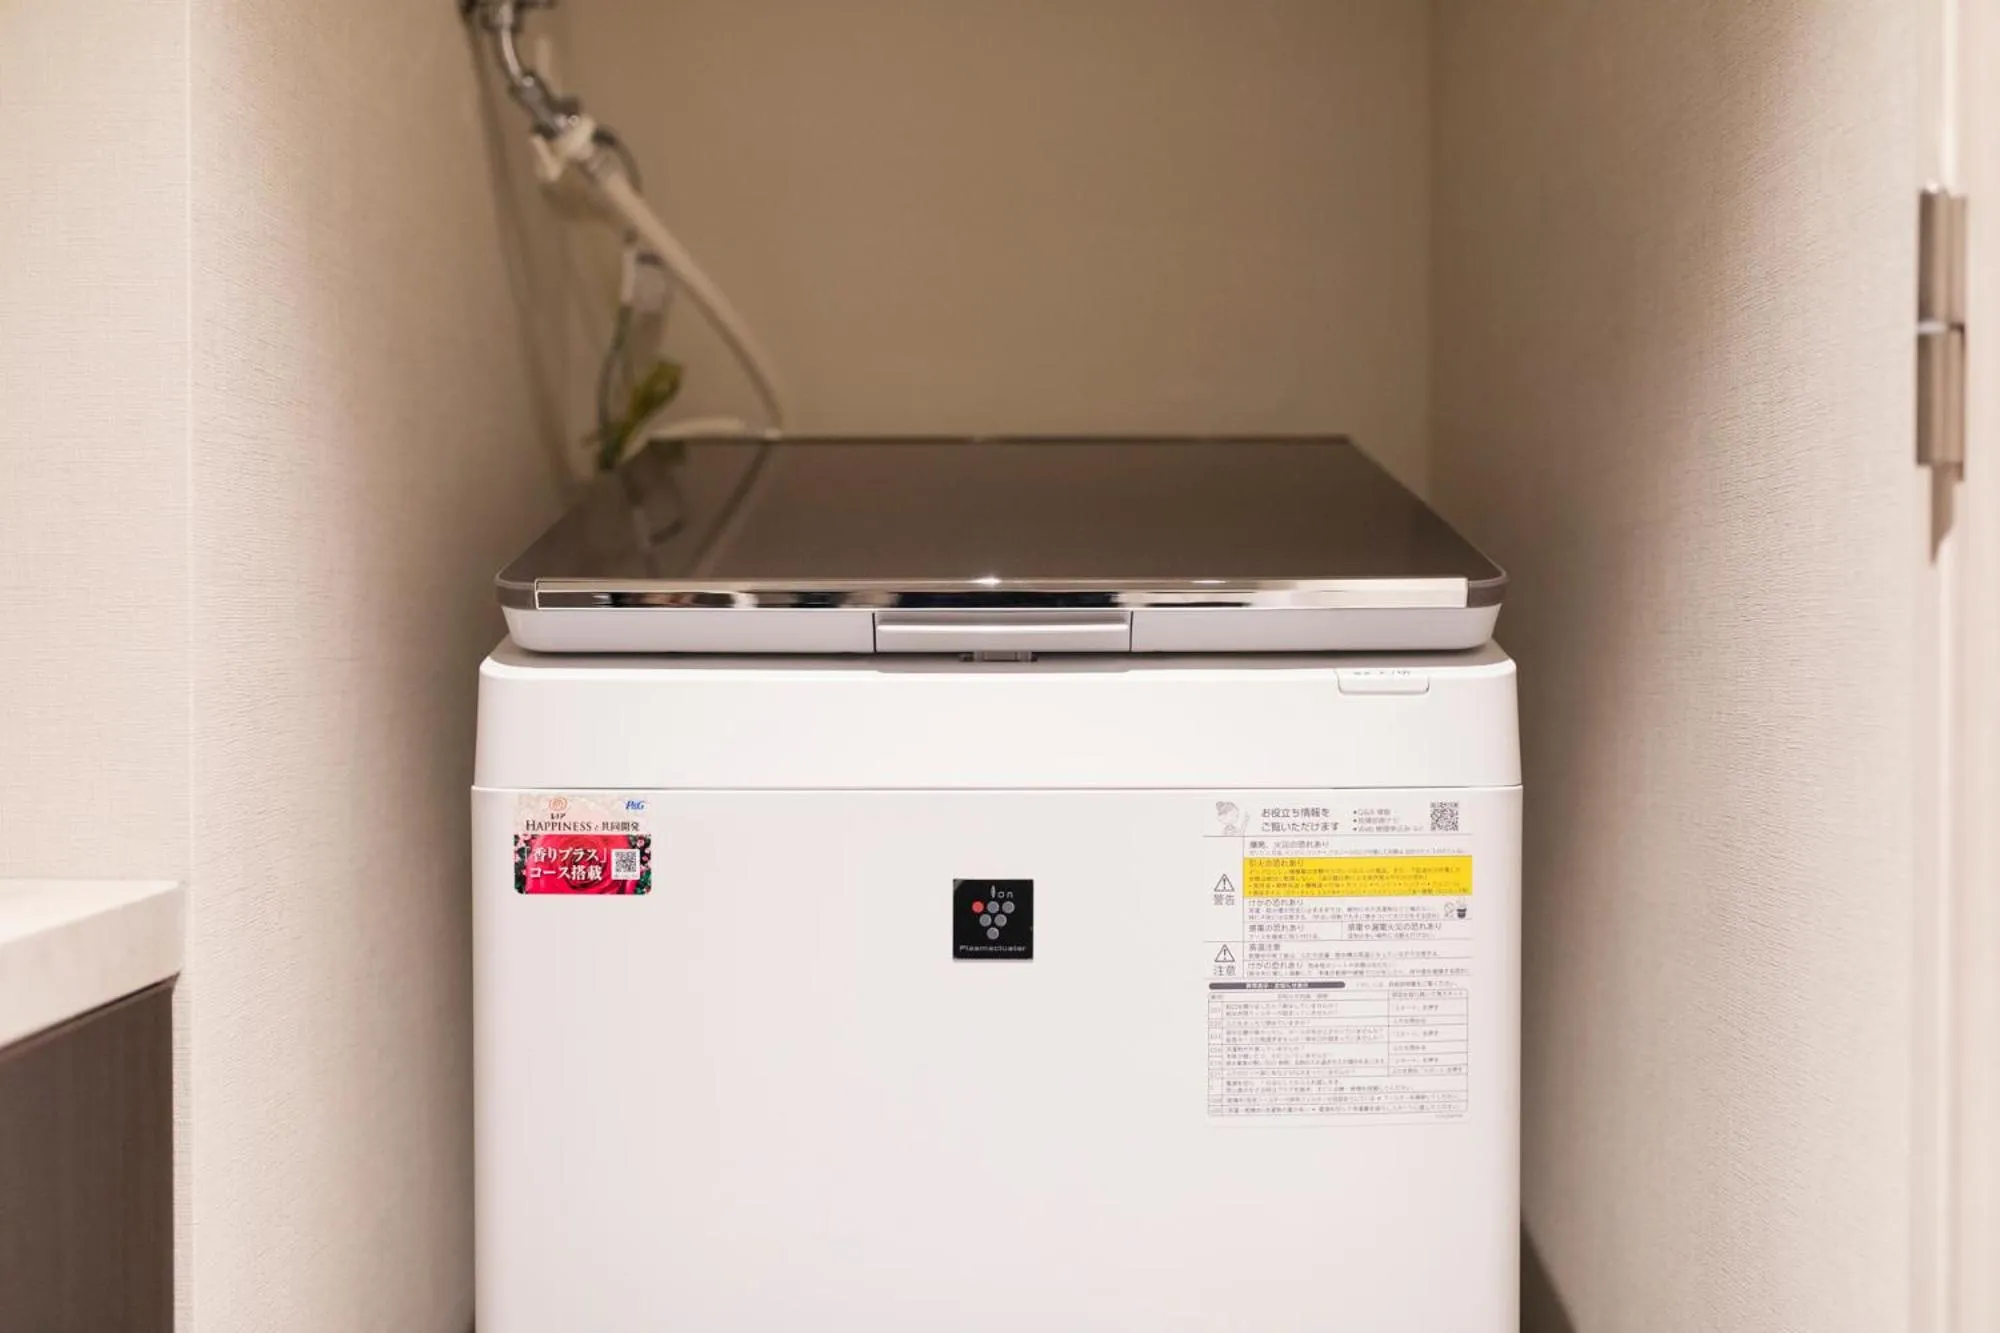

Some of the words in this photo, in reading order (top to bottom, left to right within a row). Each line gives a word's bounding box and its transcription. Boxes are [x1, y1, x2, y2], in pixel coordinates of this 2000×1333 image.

[625, 800, 645, 810] P&G
[1261, 807, 1331, 818] お役立ち情報を
[526, 820, 592, 831] HAPPINESS
[1261, 821, 1340, 832] ご覧いただけます
[529, 864, 603, 880] コース搭載
[1214, 894, 1236, 905] 警告
[1213, 965, 1236, 976] 注意
